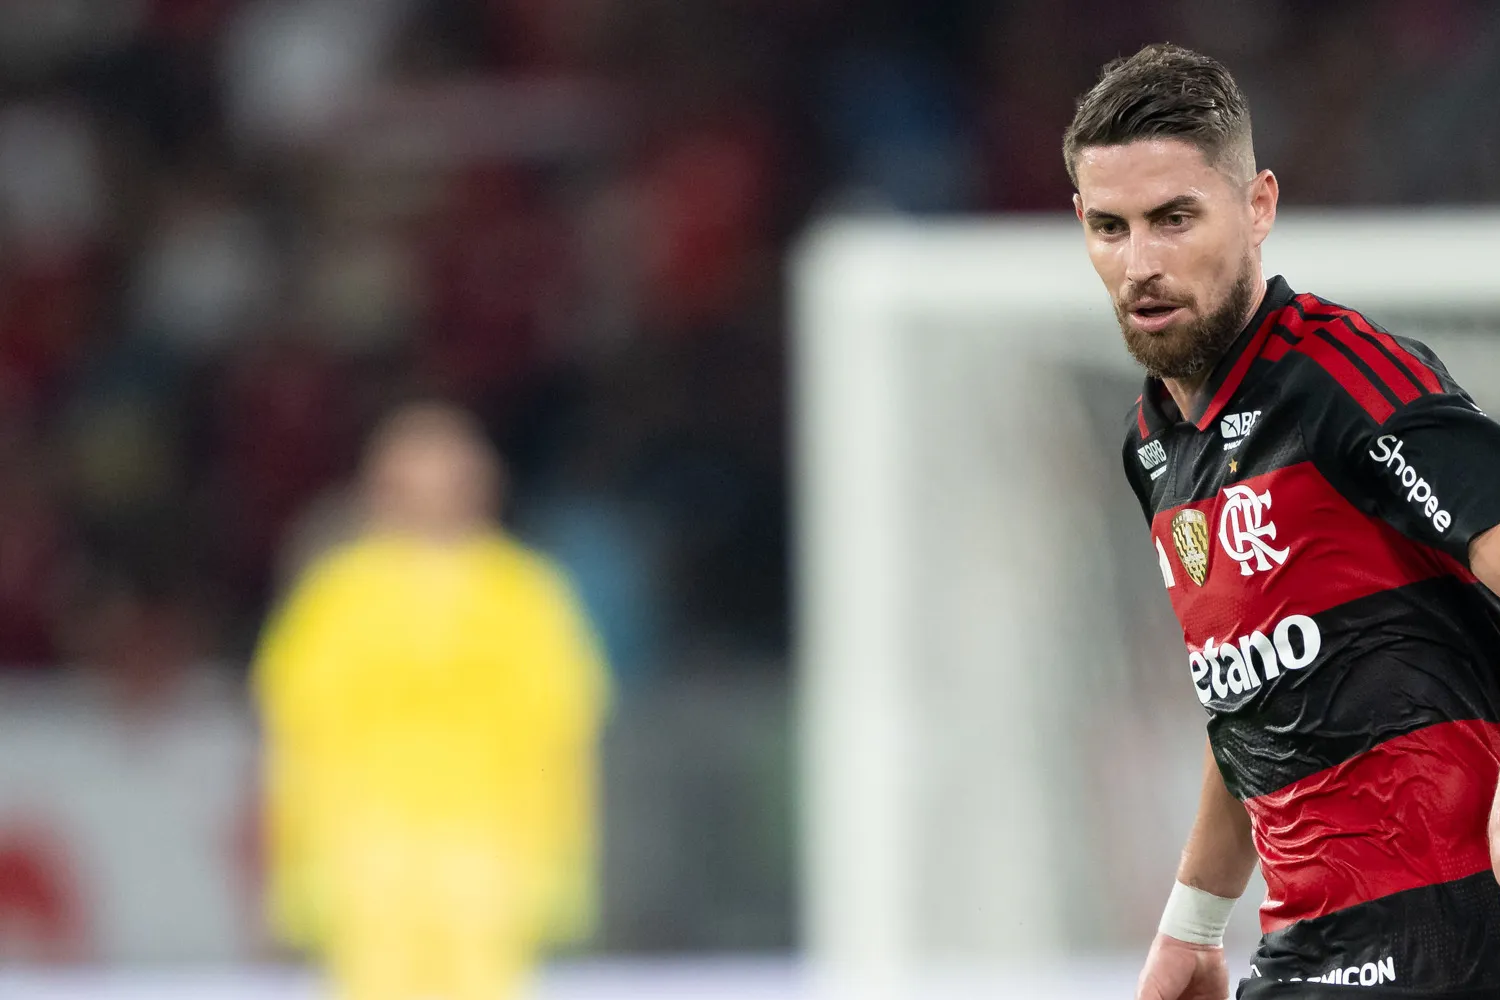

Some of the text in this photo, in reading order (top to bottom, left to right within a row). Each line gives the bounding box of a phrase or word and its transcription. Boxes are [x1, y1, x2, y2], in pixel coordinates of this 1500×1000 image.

[1143, 439, 1167, 466] BRB
[1369, 434, 1452, 533] Shopee
[1188, 614, 1322, 704] etano
